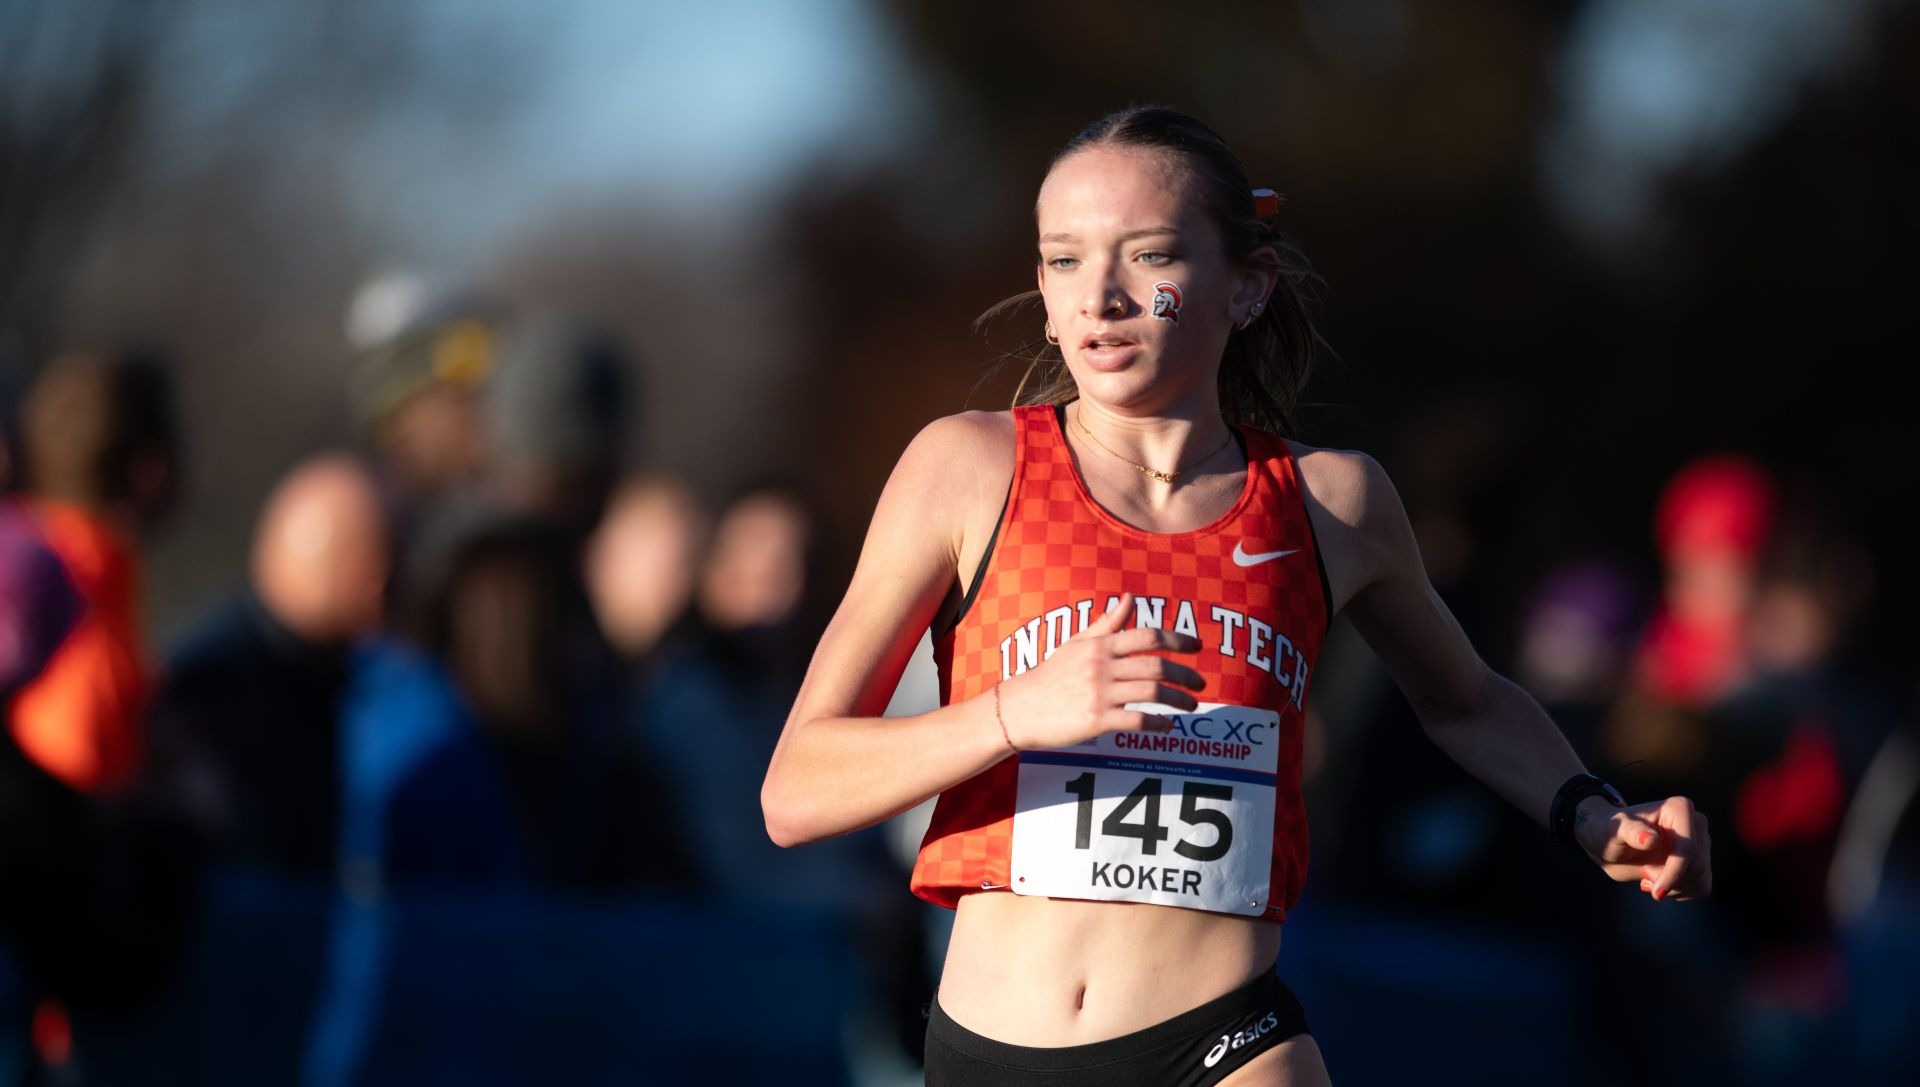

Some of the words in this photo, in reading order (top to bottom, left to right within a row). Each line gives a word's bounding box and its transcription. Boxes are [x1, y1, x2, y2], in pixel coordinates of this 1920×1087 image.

[1211, 605, 1309, 712] TECH
[1114, 732, 1252, 761] CHAMPIONSHIP
[1164, 714, 1213, 739] AC
[1223, 719, 1265, 746] XC
[1065, 772, 1234, 862] 145
[1091, 862, 1202, 896] KOKER
[1232, 1011, 1278, 1050] asics
